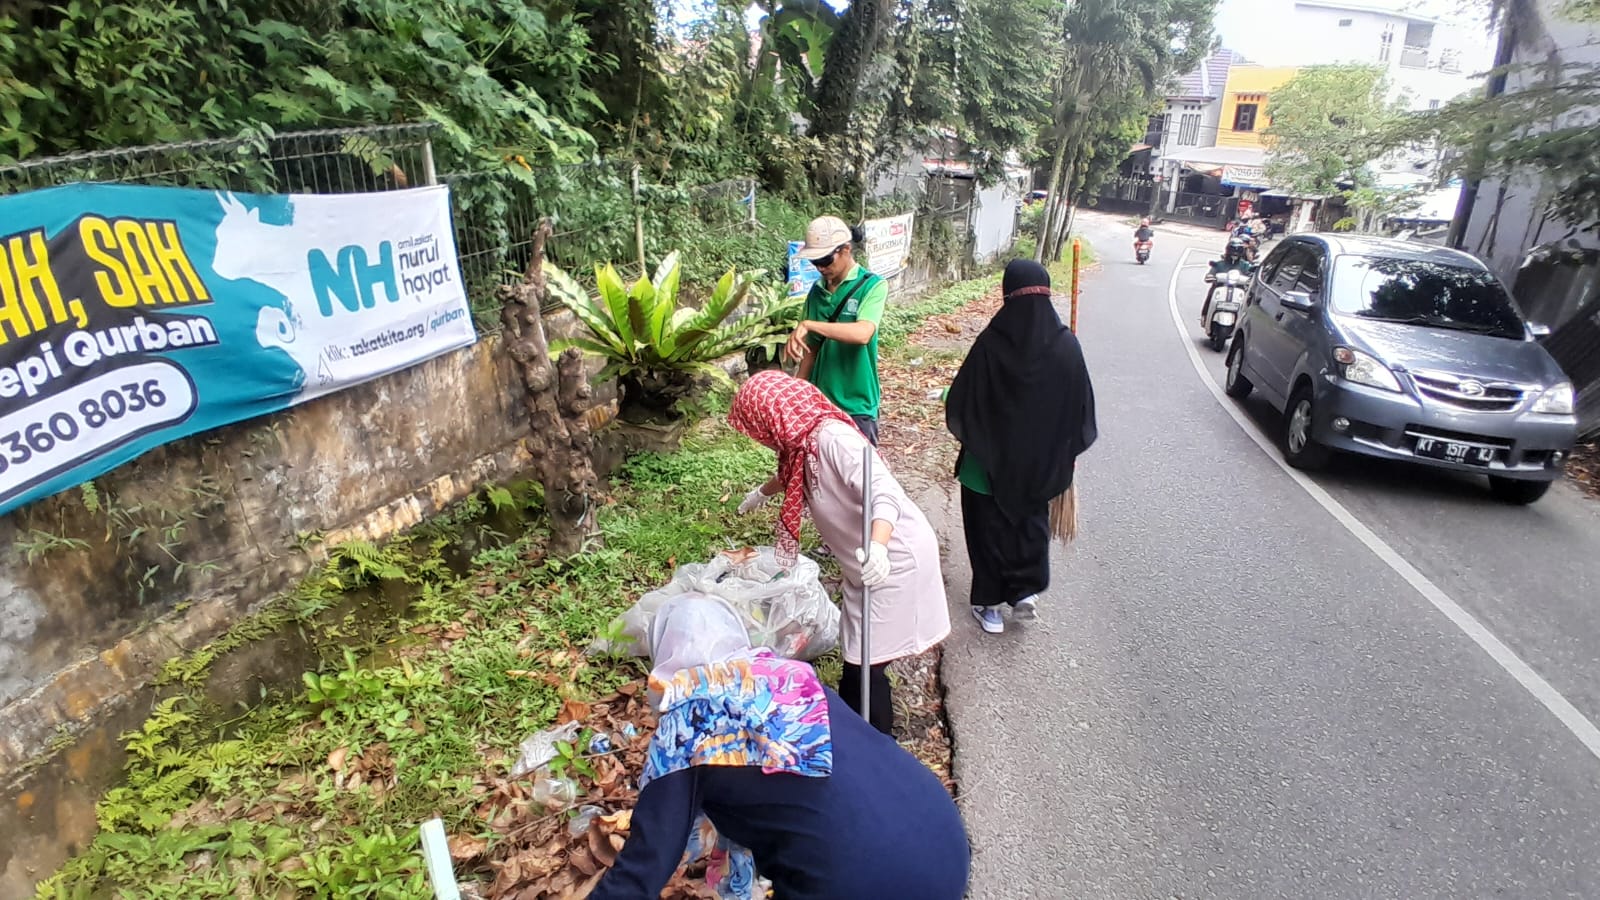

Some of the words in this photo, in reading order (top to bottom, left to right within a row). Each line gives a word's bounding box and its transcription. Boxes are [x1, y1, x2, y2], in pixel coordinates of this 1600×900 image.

[79, 217, 209, 308] SAH
[398, 237, 440, 270] nurul
[307, 240, 400, 317] NH
[401, 263, 452, 296] hayat
[64, 316, 217, 367] Qurban
[324, 345, 350, 362] klik:
[78, 379, 167, 429] 8036
[1418, 438, 1436, 452] KT
[1446, 442, 1471, 458] 1517
